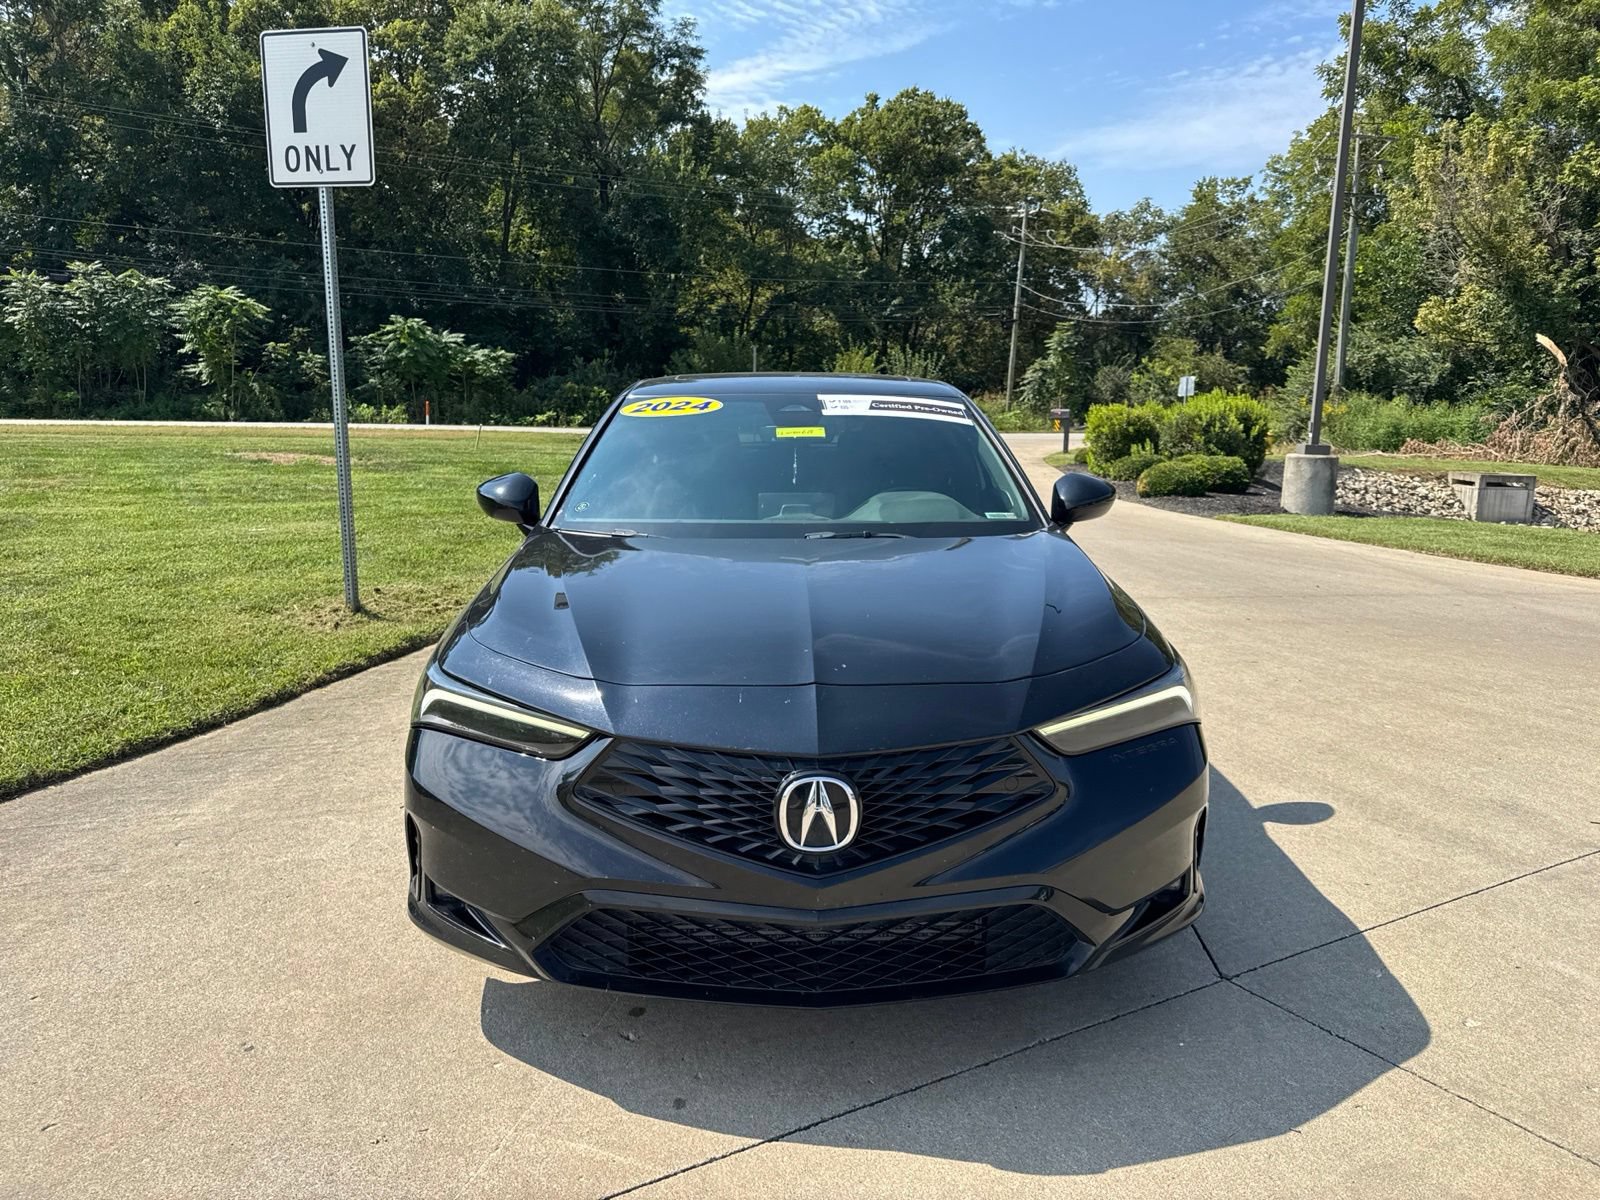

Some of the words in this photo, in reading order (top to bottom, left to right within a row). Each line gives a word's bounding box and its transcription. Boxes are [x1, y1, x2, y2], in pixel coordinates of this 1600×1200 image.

[284, 143, 356, 172] ONLY
[629, 401, 713, 413] 2024
[871, 402, 913, 410] Certified
[914, 405, 964, 416] Pre-Owned
